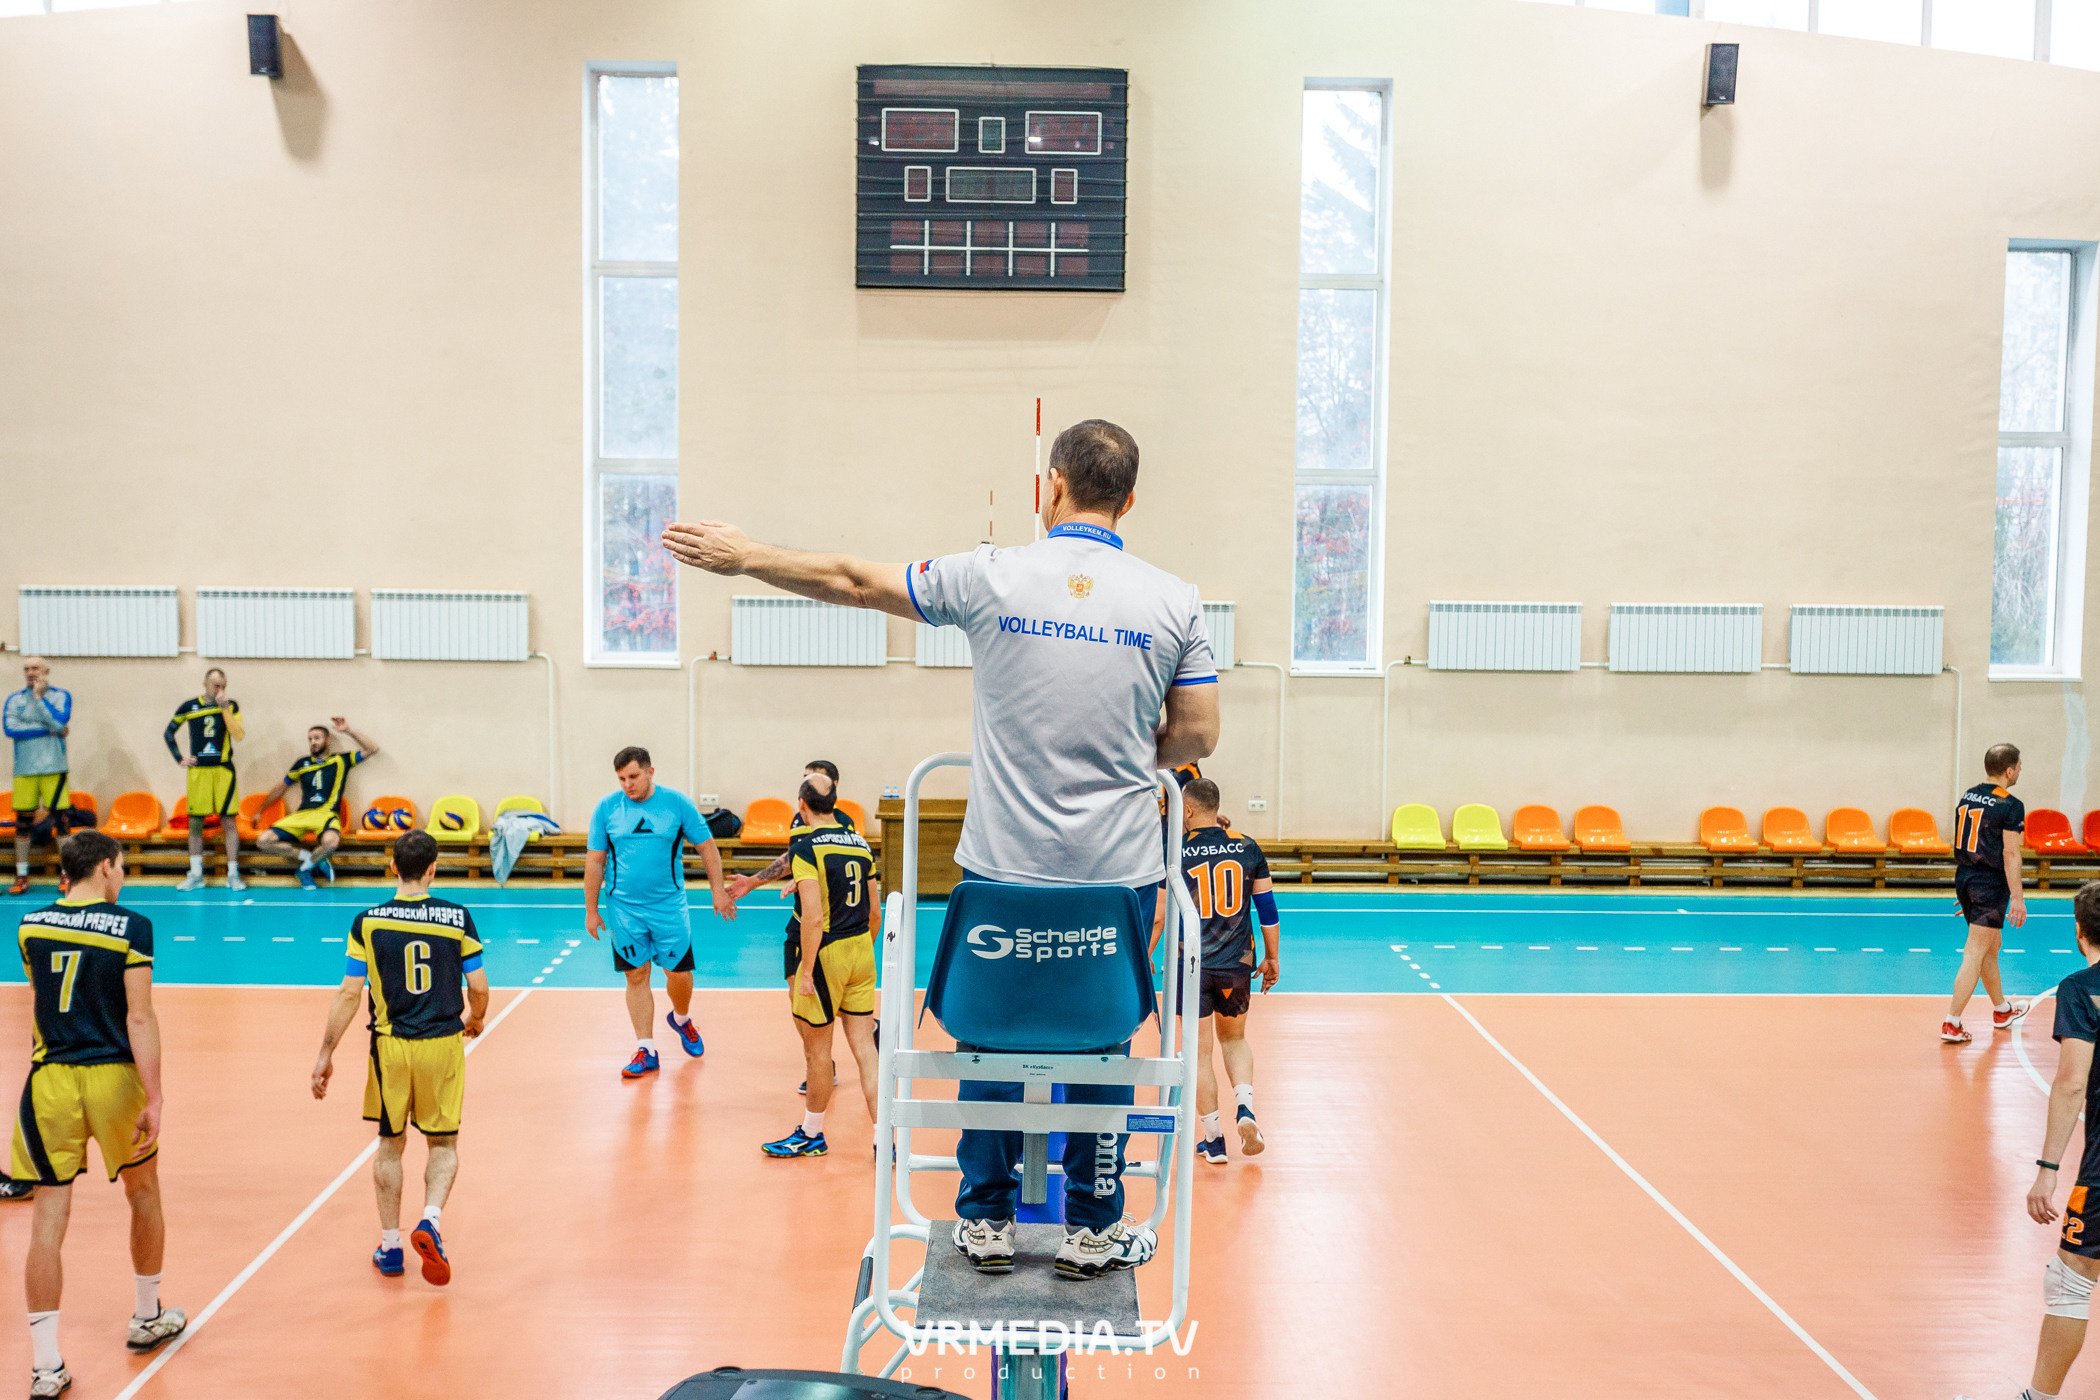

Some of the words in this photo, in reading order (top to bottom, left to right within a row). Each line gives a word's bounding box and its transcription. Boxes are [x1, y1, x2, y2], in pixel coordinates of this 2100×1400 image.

[1062, 525, 1112, 540] VOLLEYKEM.RU
[998, 615, 1109, 643] VOLLEYBALL
[1114, 628, 1153, 651] TIME
[203, 715, 215, 738] 2
[1956, 804, 1984, 853] 11
[1182, 842, 1245, 858] КУЗБАСС
[844, 860, 862, 907] 3
[1187, 859, 1244, 919] 10
[84, 912, 129, 937] РАЗРЕЗ
[368, 904, 428, 921] КЕДРОВСКИЙ
[428, 907, 465, 928] РАЗРЕЗ
[1015, 926, 1117, 944] Schelde
[621, 944, 636, 959] 11
[1015, 941, 1117, 963] Sports
[404, 940, 431, 995] 6
[51, 950, 82, 1013] 7
[1094, 1132, 1118, 1199] oma
